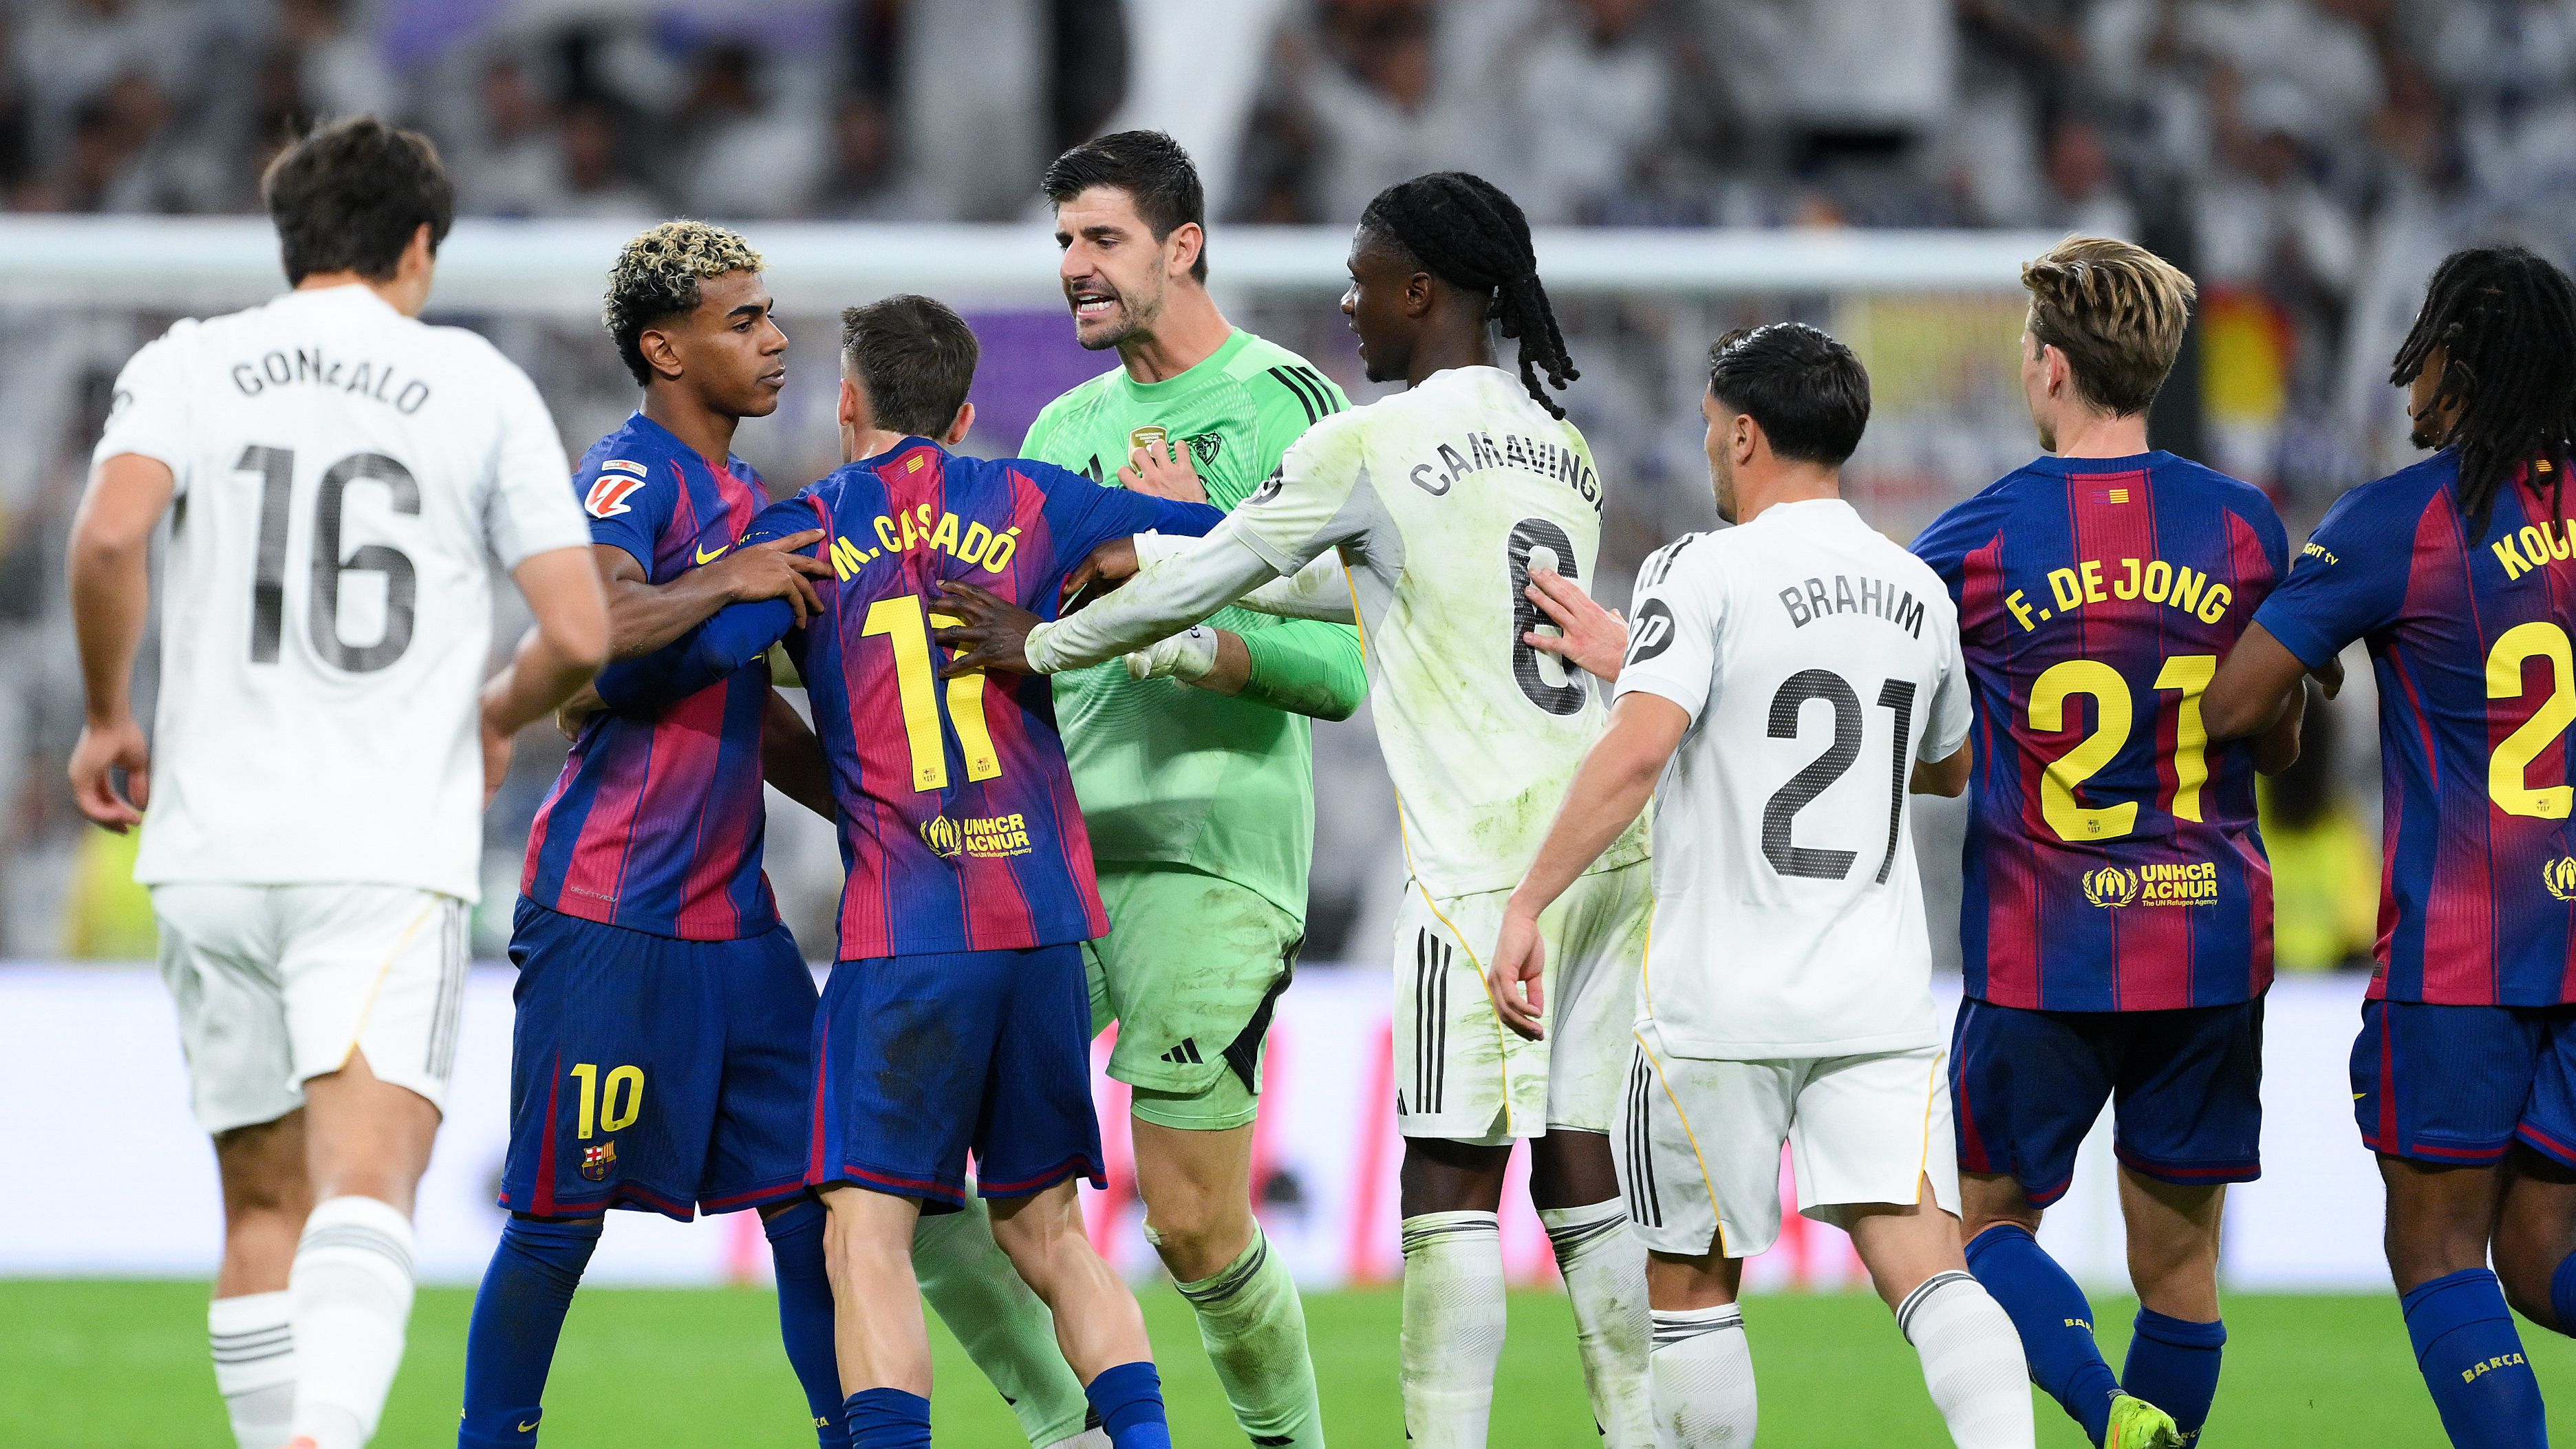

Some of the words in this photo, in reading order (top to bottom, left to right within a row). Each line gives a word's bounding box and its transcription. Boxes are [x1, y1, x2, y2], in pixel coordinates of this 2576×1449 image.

[829, 534, 880, 582] M.
[873, 502, 1023, 574] CASADÓ
[232, 444, 422, 674] 16
[2325, 552, 2339, 566] tv
[1779, 575, 1924, 641] BRAHIM
[2005, 589, 2051, 632] F.
[2048, 560, 2107, 612] DE
[2114, 558, 2233, 625] JONG
[861, 593, 1003, 793] 17
[2027, 654, 2218, 841] 21
[1761, 669, 1917, 886] 21
[964, 813, 1025, 835] UNHCR
[966, 830, 1030, 852] ACNUR
[1010, 847, 1032, 856] Agency
[2140, 862, 2216, 882] UNHCR
[2142, 880, 2218, 899] ACNUR
[2195, 899, 2218, 907] Agency
[570, 1064, 644, 1139] 10
[2064, 1318, 2093, 1334] BAR
[2461, 1353, 2524, 1384] BARÇA
